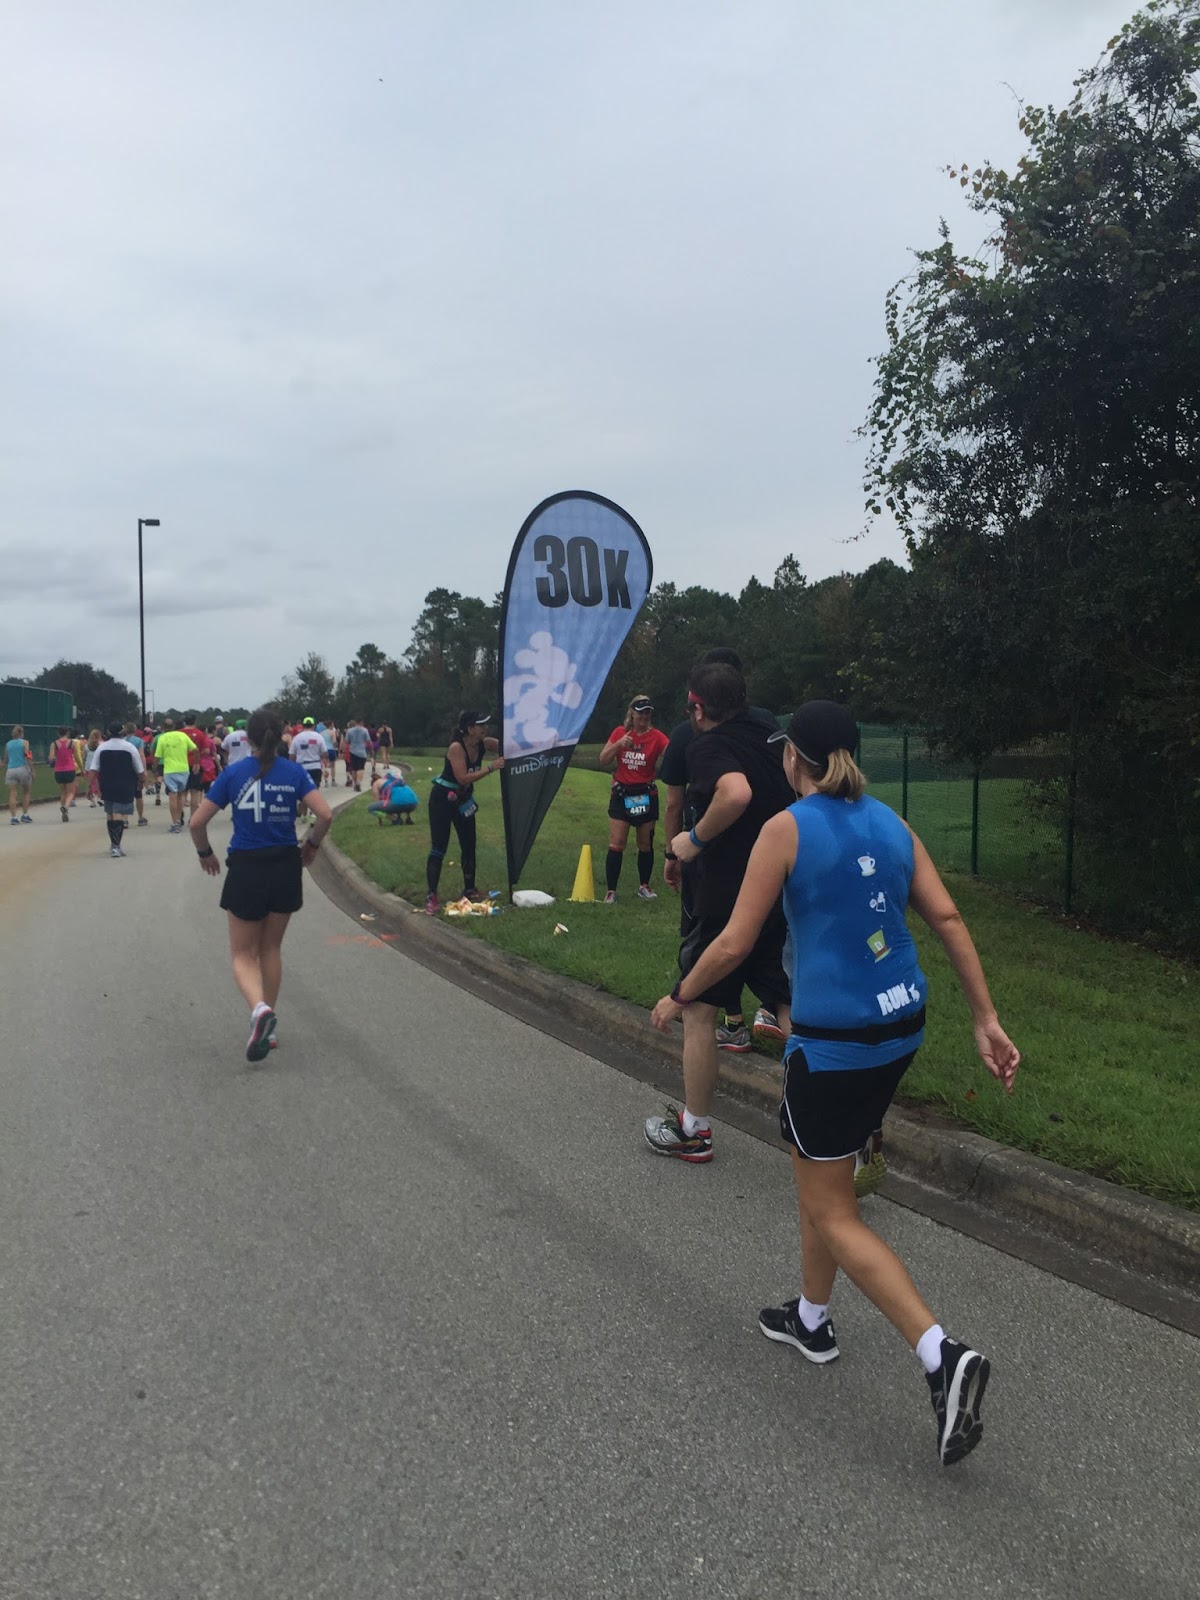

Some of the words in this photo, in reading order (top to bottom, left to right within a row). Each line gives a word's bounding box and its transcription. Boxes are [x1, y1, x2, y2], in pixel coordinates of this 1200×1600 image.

[534, 535, 632, 609] 30K
[625, 751, 645, 760] RUN
[237, 778, 266, 823] 4
[630, 805, 646, 814] 4471
[876, 982, 911, 1017] RUN
